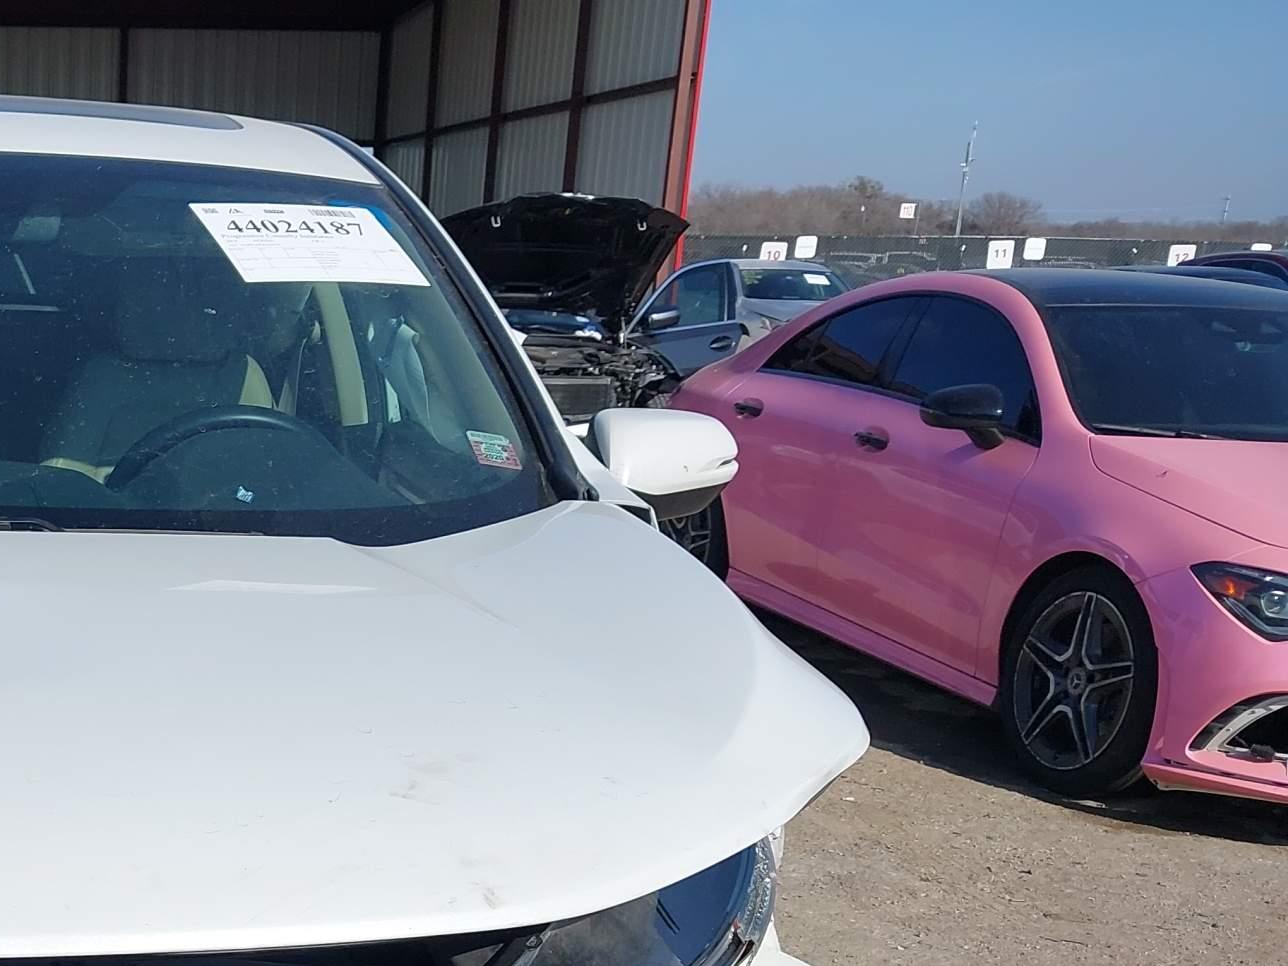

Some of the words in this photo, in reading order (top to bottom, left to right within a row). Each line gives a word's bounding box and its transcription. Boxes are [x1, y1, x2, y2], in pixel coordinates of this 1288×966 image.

[227, 219, 364, 236] 44024187
[766, 250, 781, 260] 10
[994, 249, 1008, 259] 11
[1174, 252, 1190, 263] 12
